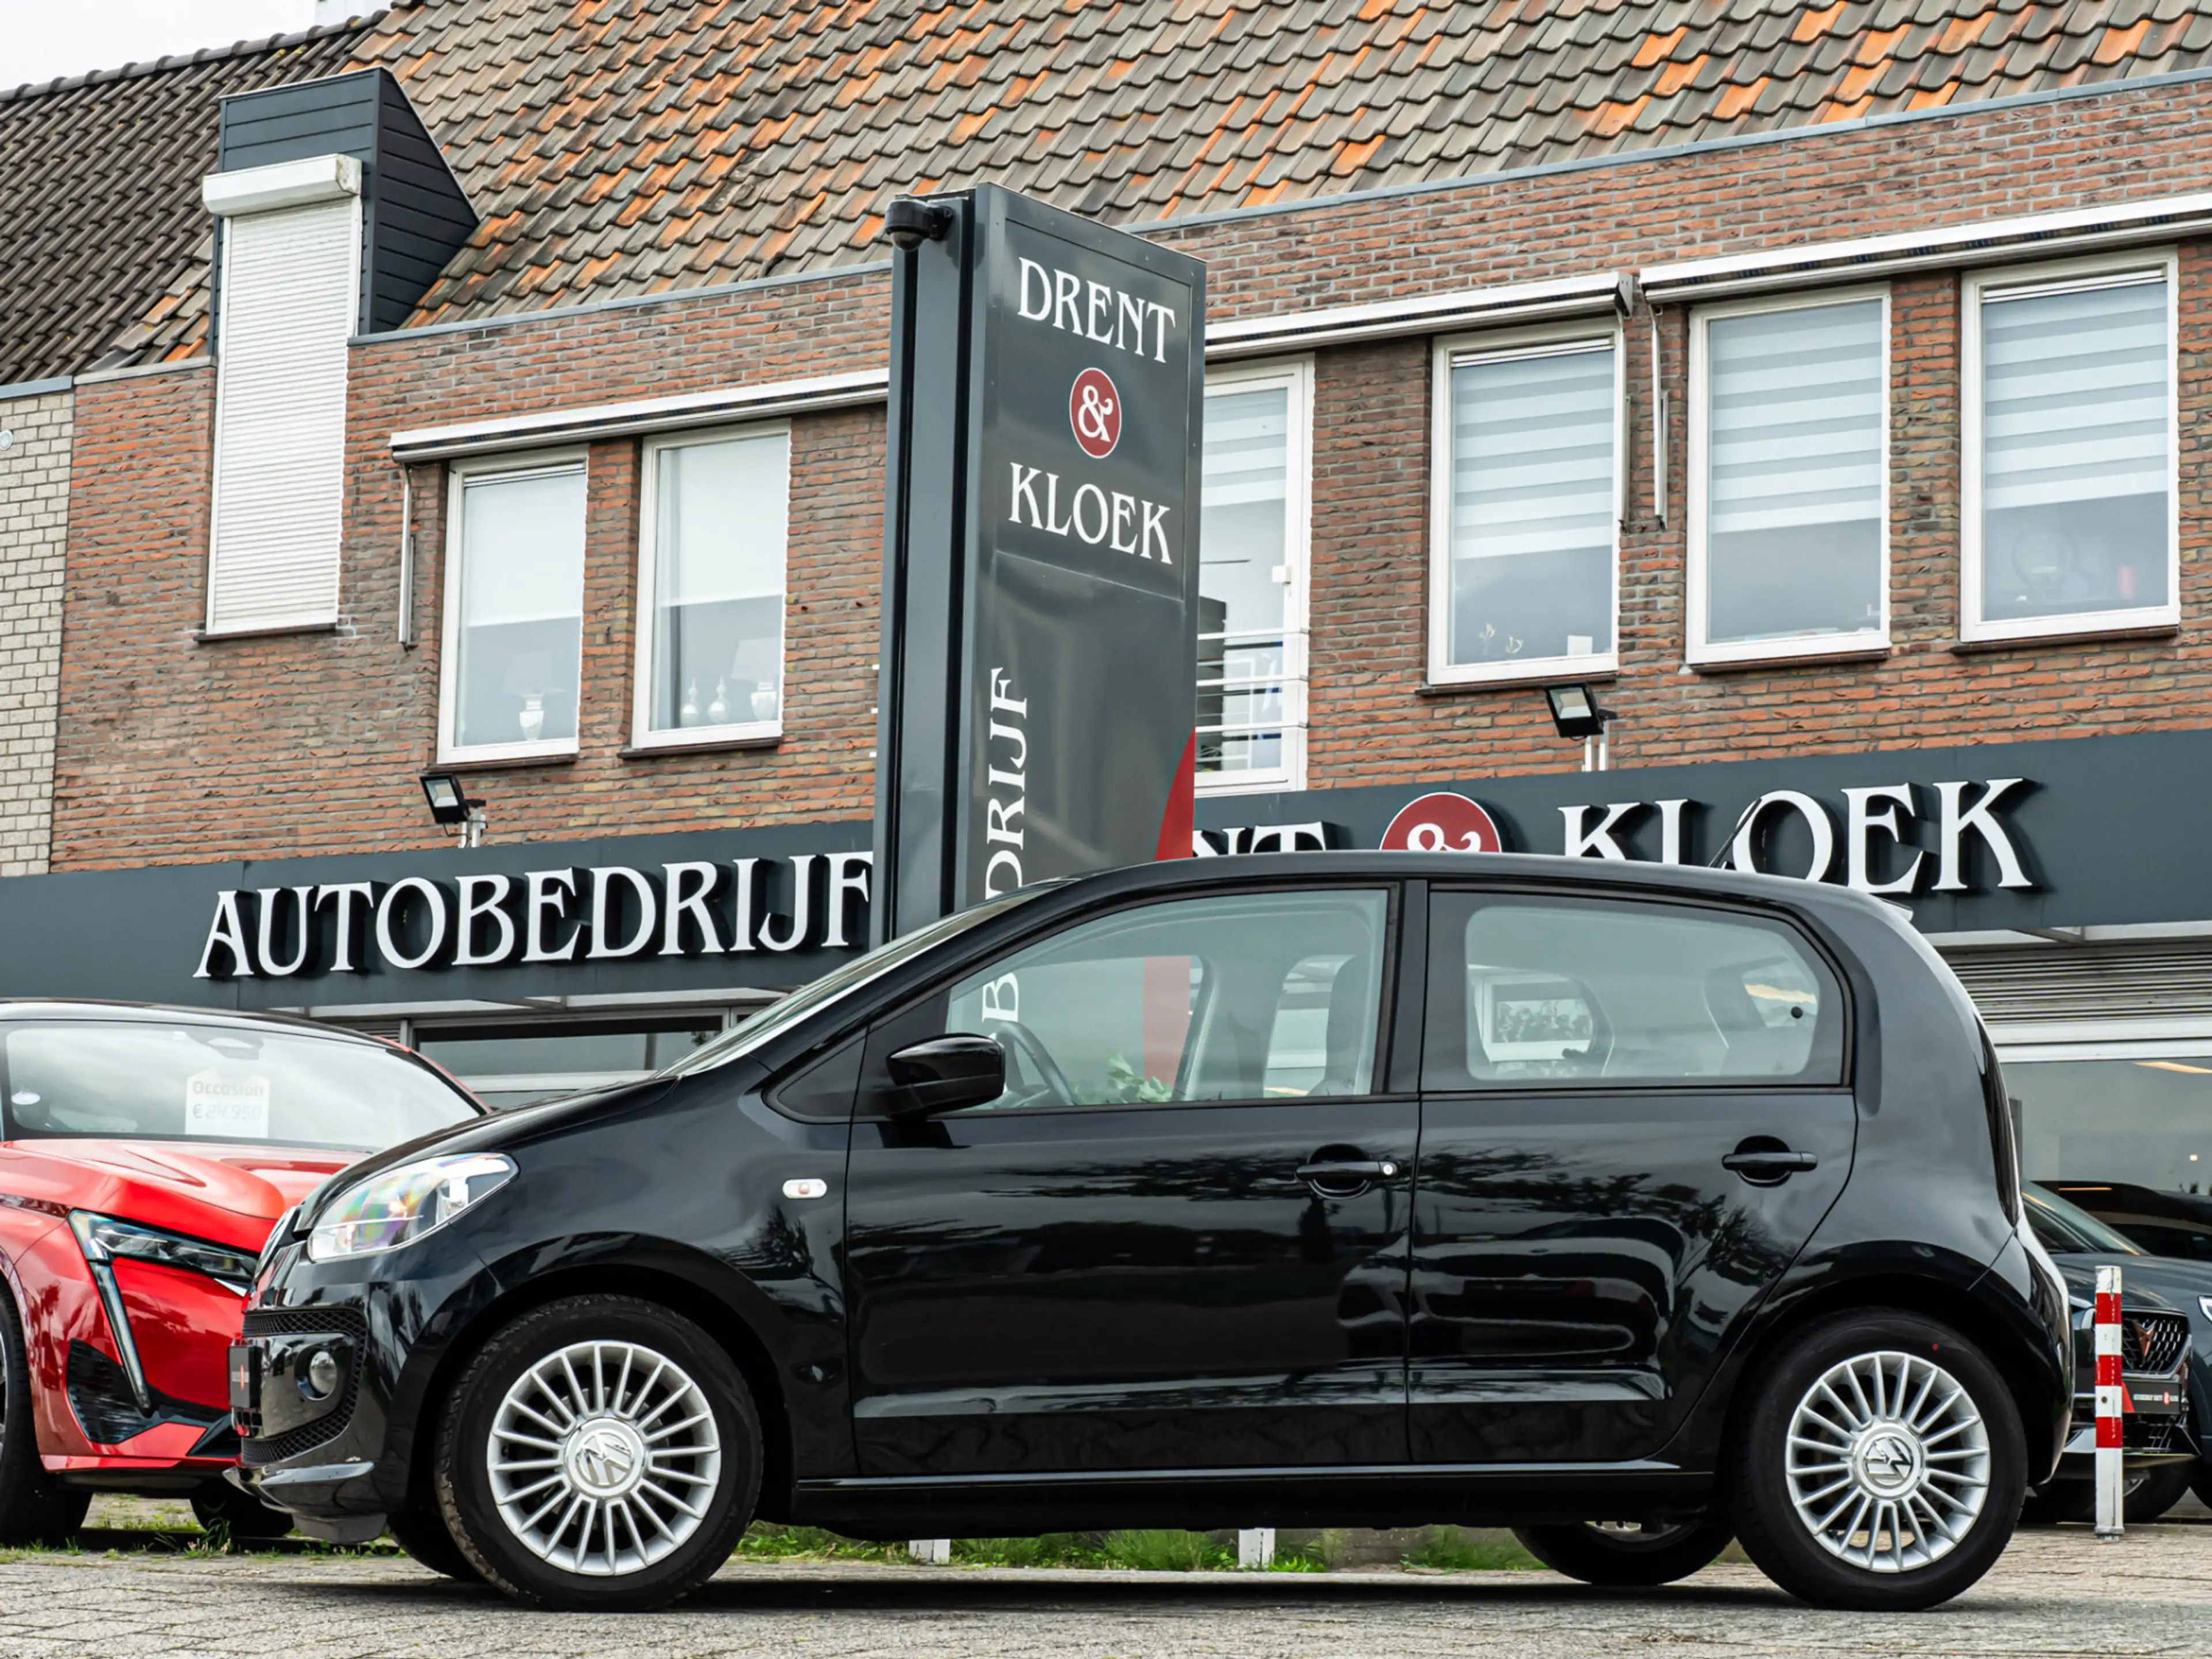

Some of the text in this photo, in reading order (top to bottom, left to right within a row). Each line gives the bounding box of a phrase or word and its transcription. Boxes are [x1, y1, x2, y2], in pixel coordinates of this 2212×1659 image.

[1017, 257, 1176, 363] DRENT
[1078, 385, 1113, 442] &
[1009, 462, 1172, 565] KLOEK
[192, 851, 873, 978] AUTOBEDRIJF
[194, 1081, 264, 1096] Occasion
